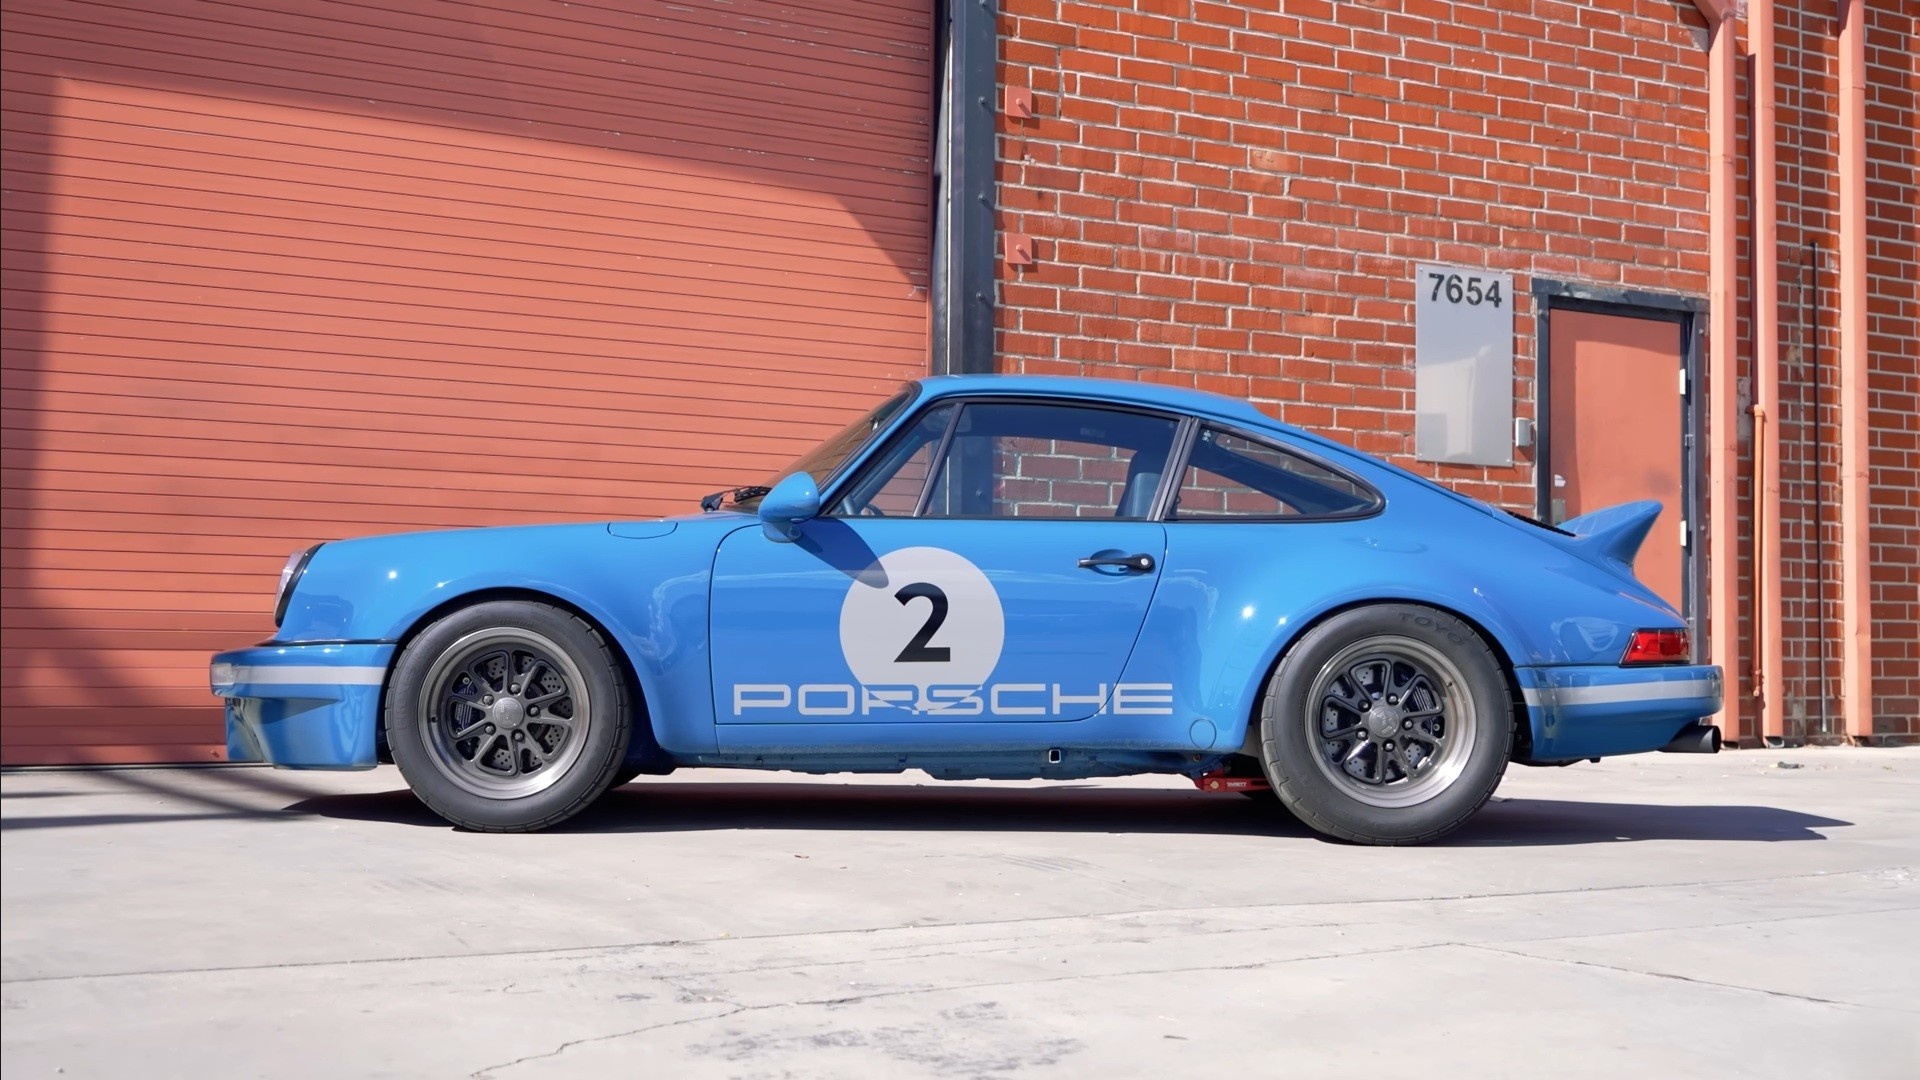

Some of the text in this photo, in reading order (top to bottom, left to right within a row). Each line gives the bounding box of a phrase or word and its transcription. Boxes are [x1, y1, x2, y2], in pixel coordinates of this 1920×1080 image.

[1428, 273, 1502, 308] 7654
[893, 582, 951, 663] 2
[1397, 612, 1466, 646] TOYO
[733, 683, 1173, 716] PORSCHE
